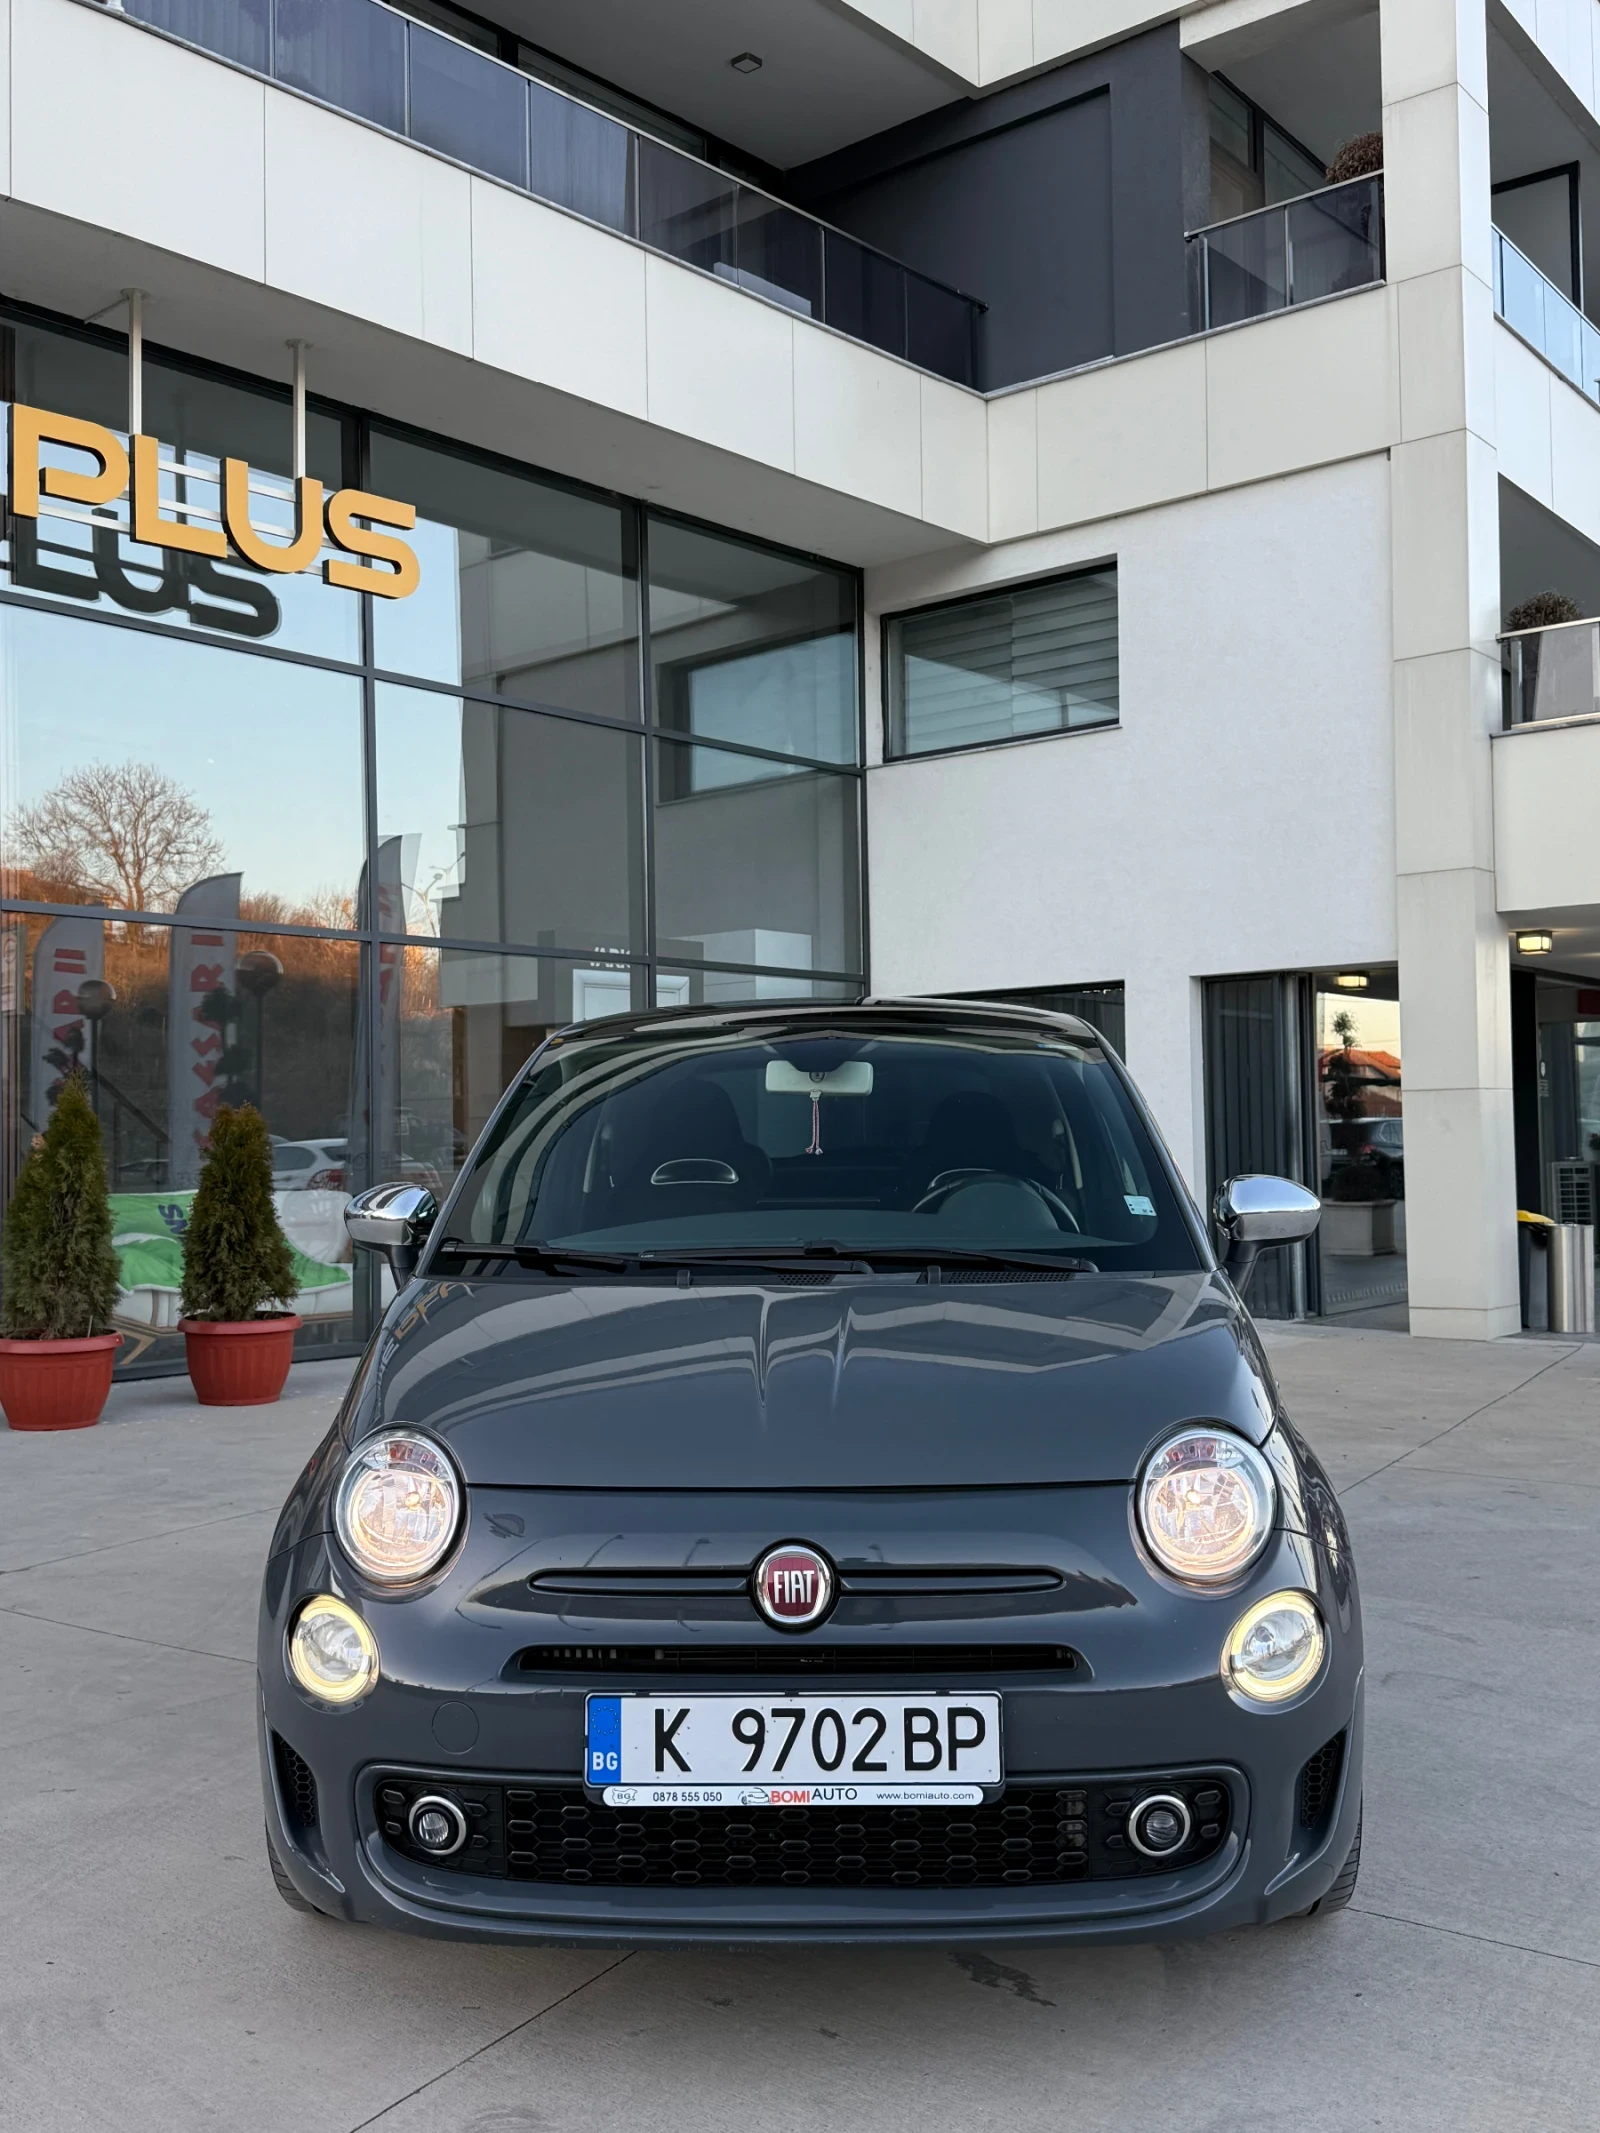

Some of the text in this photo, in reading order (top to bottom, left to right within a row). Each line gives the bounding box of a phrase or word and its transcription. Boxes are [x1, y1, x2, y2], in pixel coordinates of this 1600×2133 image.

[8, 402, 421, 599] PLUS
[773, 1570, 815, 1604] FIAT
[654, 1708, 692, 1772] K
[731, 1707, 888, 1772] 9702
[592, 1752, 618, 1771] BG
[652, 1791, 722, 1802] 0878 555 050
[875, 1790, 975, 1801] www.bomiauto.com
